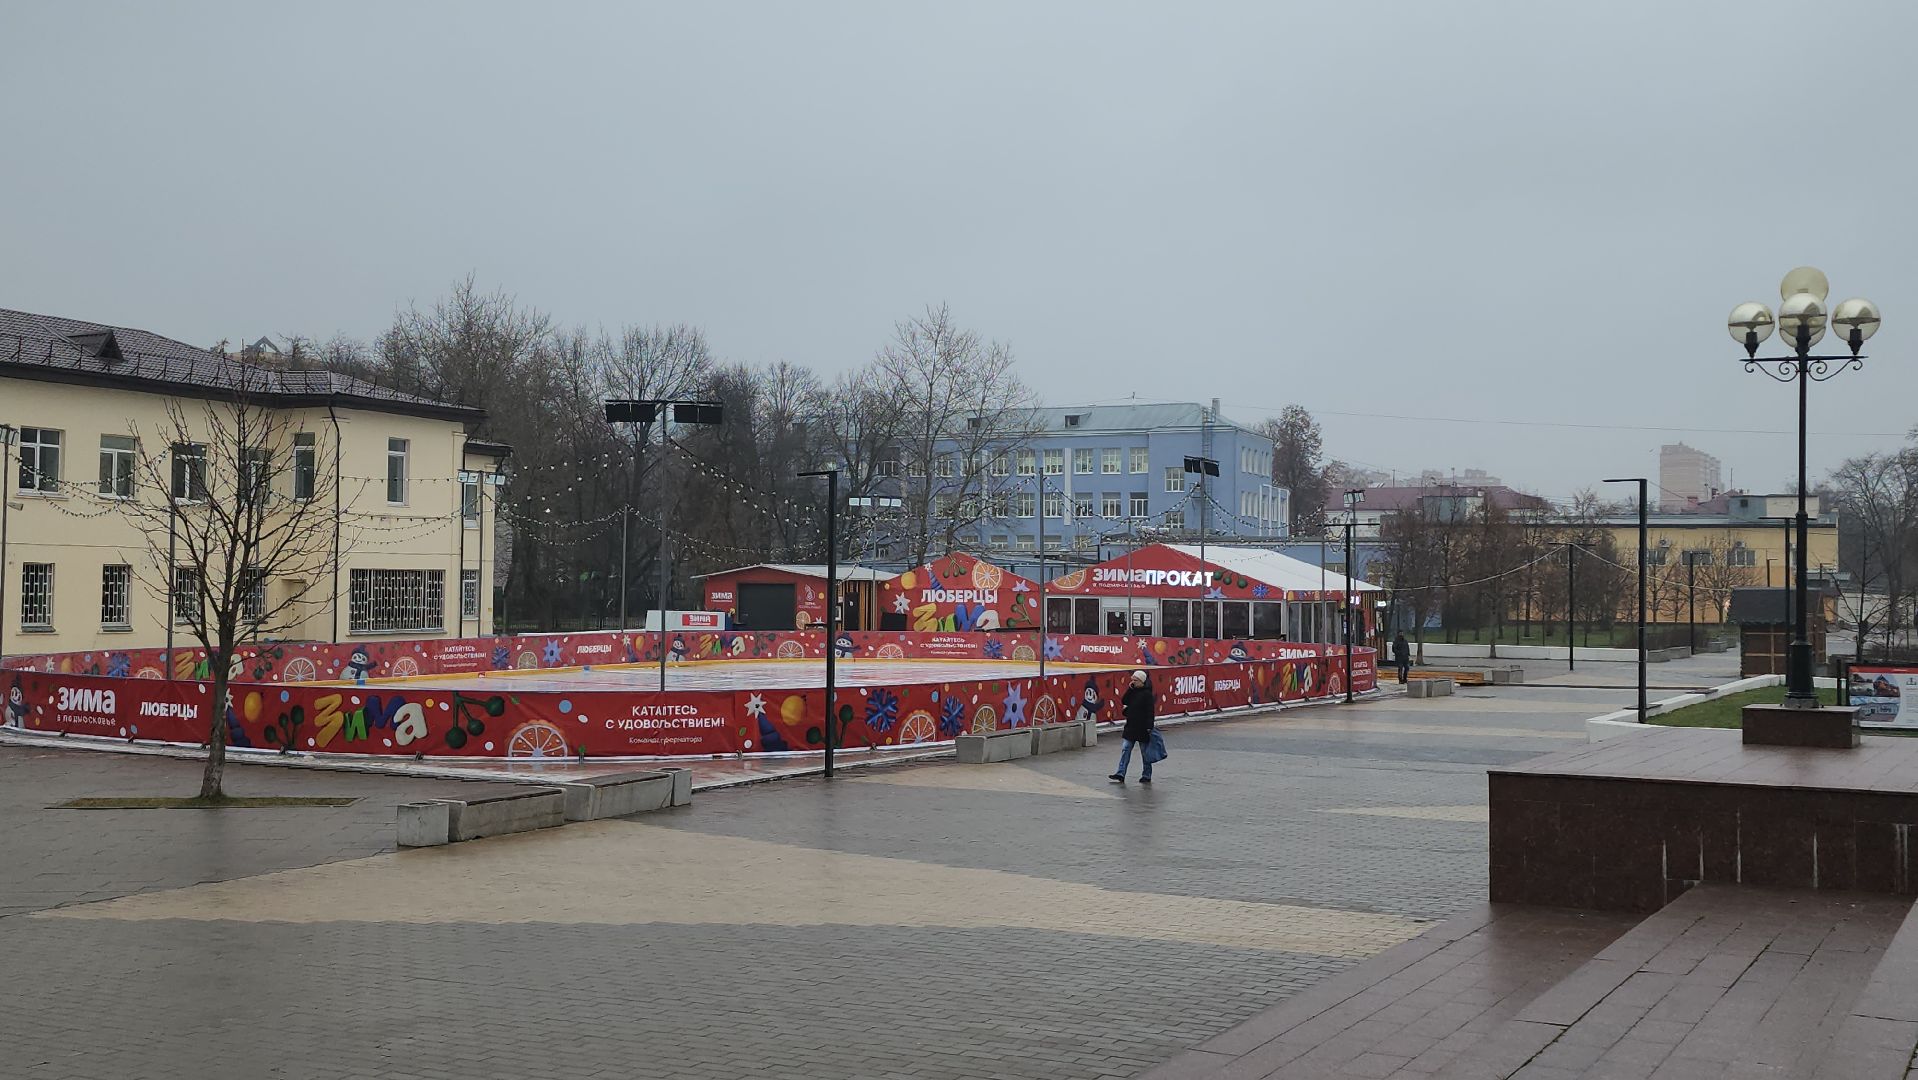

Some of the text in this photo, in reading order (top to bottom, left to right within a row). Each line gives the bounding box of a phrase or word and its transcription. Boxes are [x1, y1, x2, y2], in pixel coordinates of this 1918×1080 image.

[1145, 569, 1213, 588] ПРОКАТ
[921, 589, 998, 606] ЛЮБЕРЦЫ
[576, 644, 612, 655] ЛЮБЕРЦЫ
[1080, 645, 1123, 654] ЛЮБЕРЦЫ
[139, 701, 198, 720] ЛЮБЕРЦЫ
[605, 717, 725, 730] С УДОВОЛЬСТВИЕМ!
